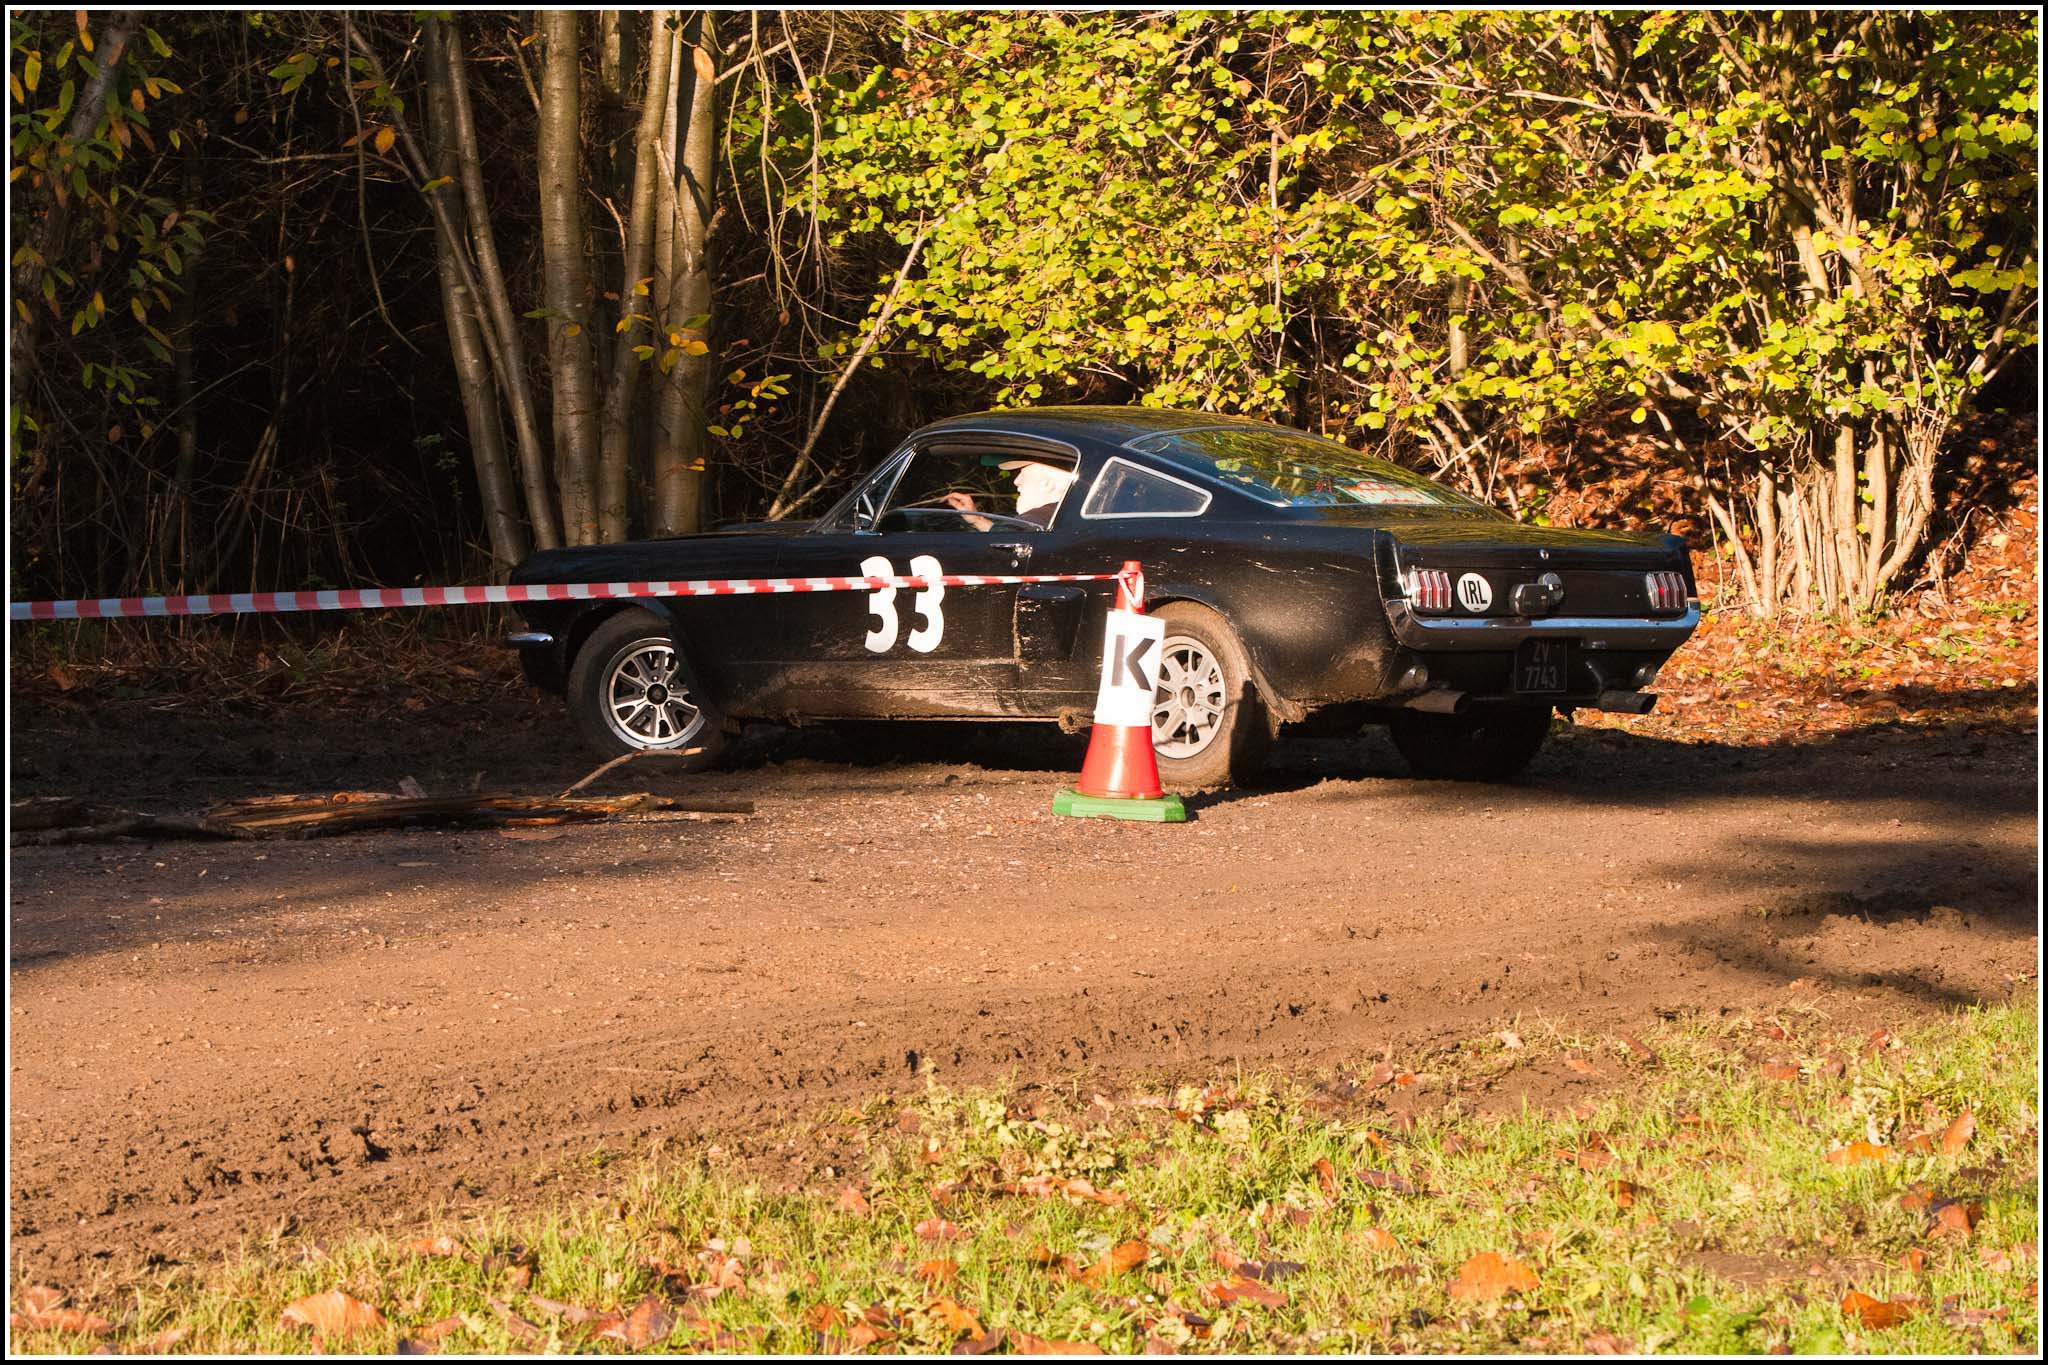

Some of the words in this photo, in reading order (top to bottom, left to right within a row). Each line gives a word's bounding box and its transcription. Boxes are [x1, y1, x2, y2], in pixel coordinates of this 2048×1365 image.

[860, 554, 945, 653] 33
[1463, 580, 1488, 604] IRL
[1111, 634, 1156, 691] K
[1525, 666, 1557, 689] 7743
